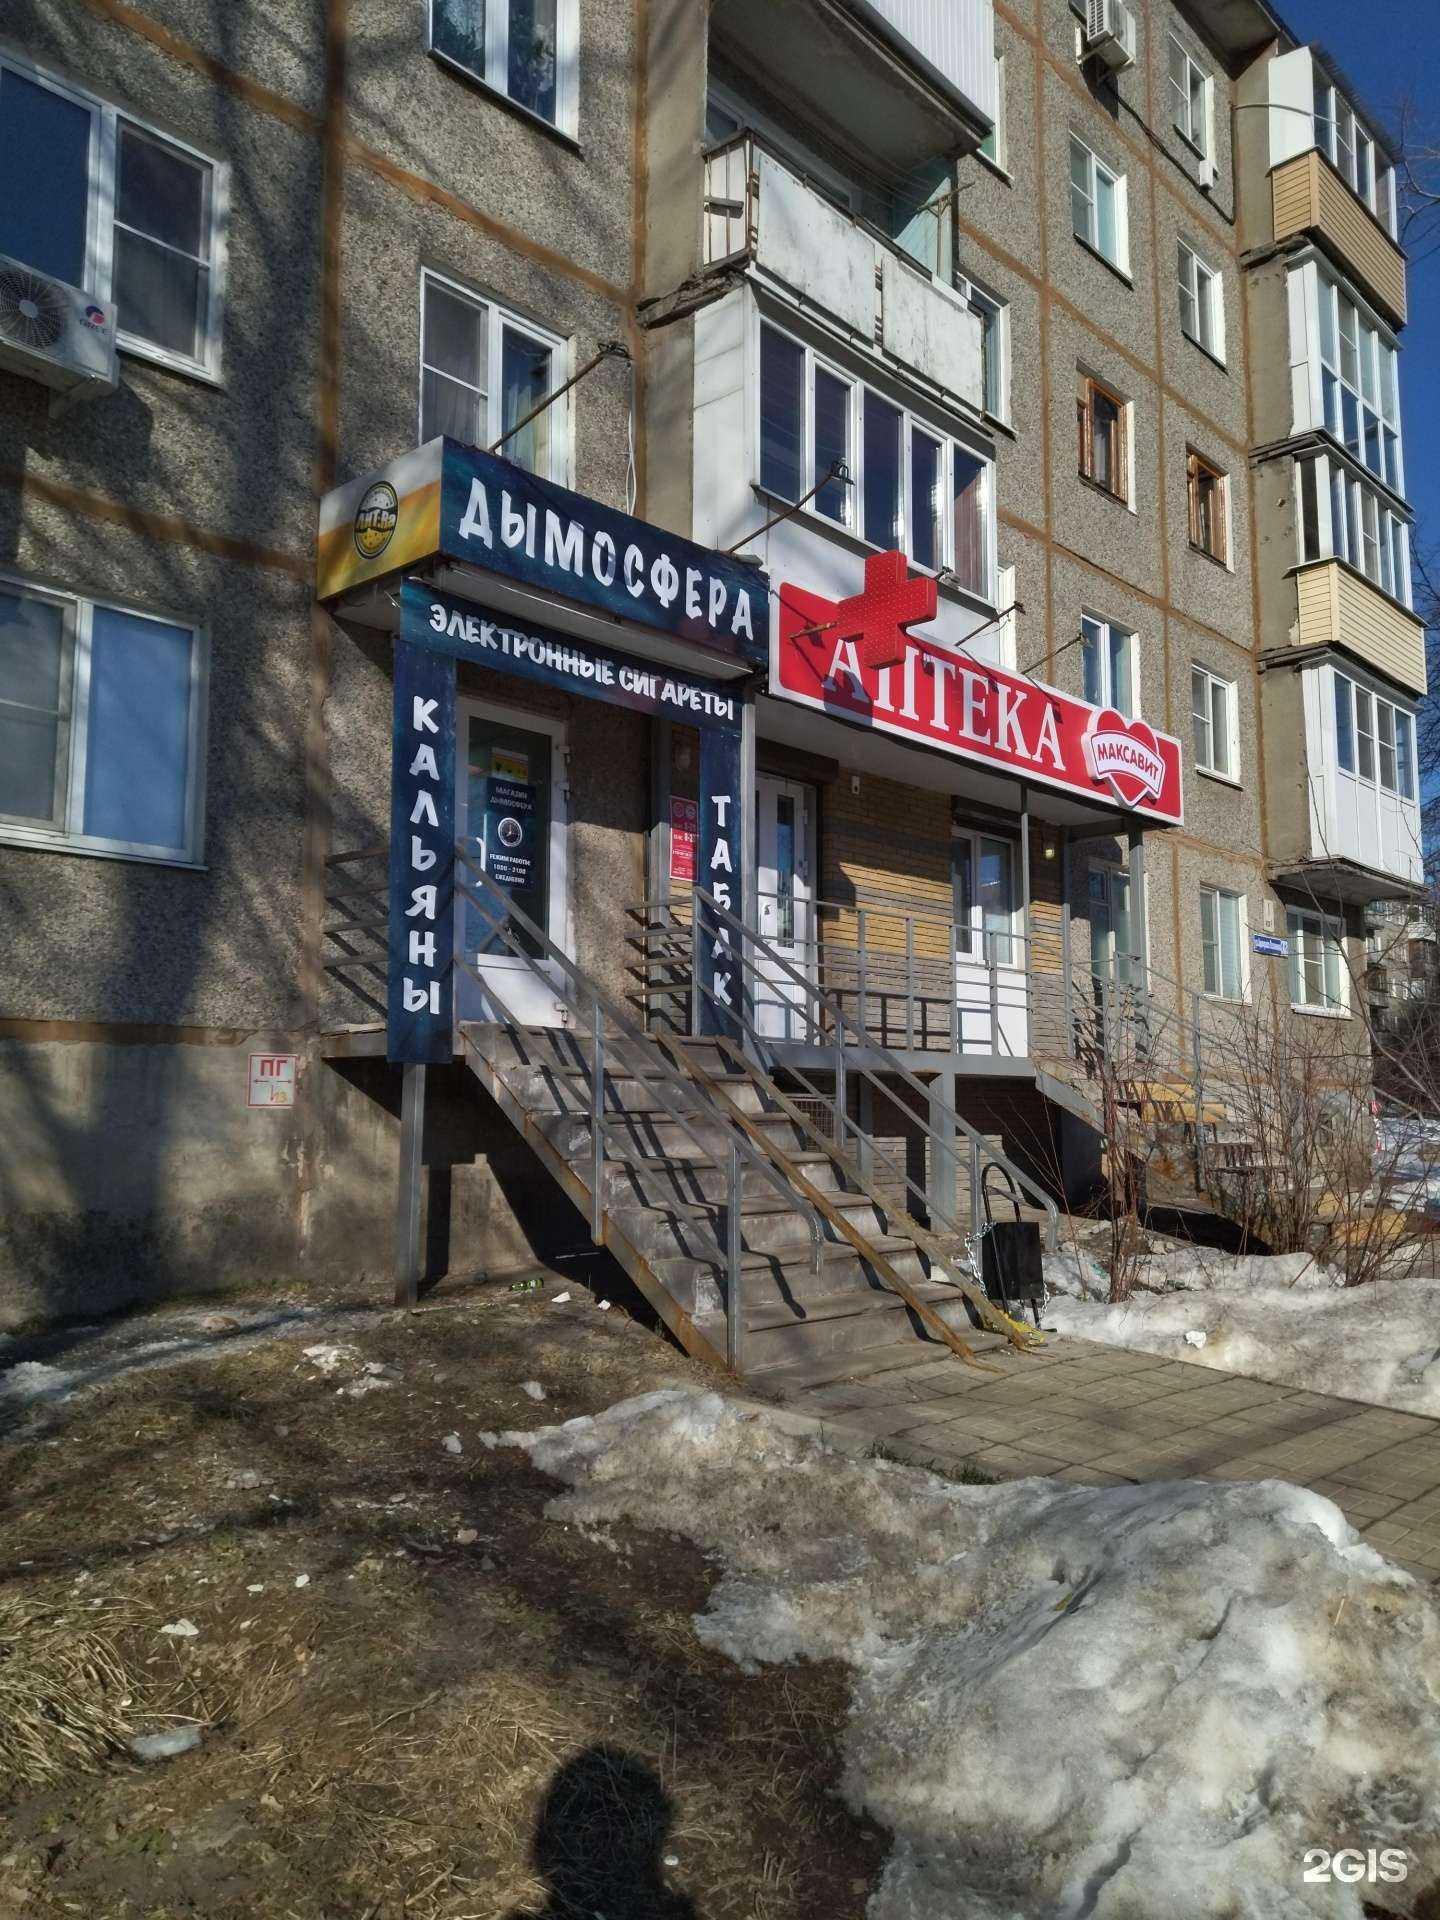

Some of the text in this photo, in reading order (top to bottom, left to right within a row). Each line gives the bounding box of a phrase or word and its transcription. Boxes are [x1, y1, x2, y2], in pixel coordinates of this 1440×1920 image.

[458, 477, 754, 640] ДЫМОСФЕРА
[429, 603, 734, 721] ЭЛЕКТРОННЫЕ СИГАРЕТЫ
[821, 638, 1066, 772] АПТЕКА
[1097, 742, 1159, 782] МАКСАВИТ
[402, 695, 441, 1015] КАЛЬЯНЫ
[710, 795, 733, 1006] ТАБАК
[260, 1059, 288, 1077] ПГ
